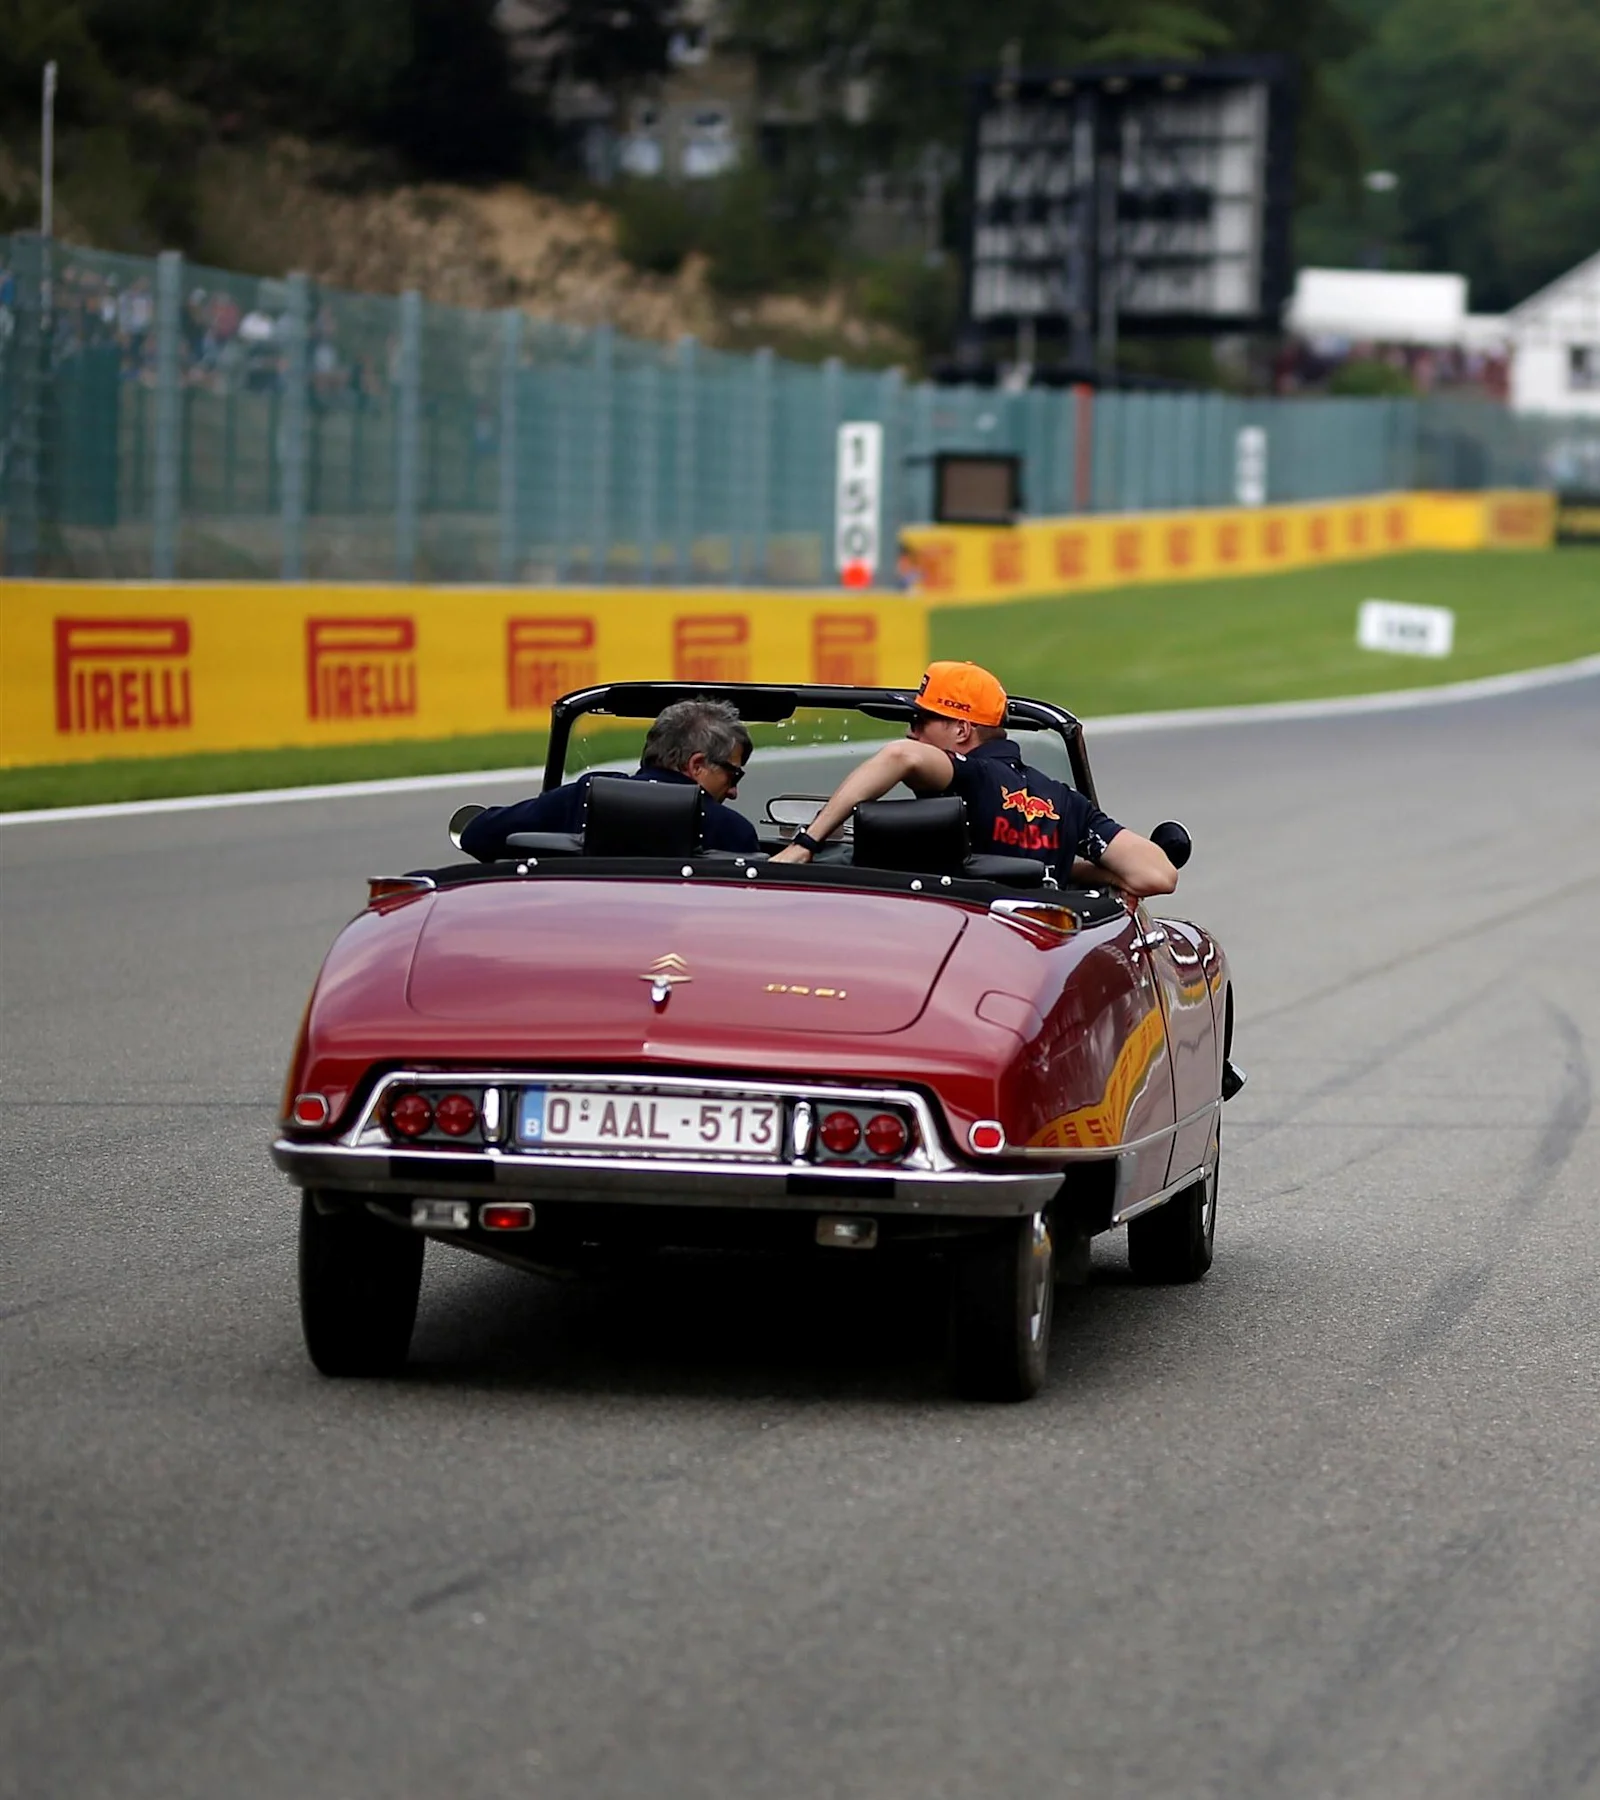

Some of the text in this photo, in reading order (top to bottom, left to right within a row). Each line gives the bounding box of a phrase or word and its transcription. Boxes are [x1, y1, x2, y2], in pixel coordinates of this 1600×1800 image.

[843, 435, 870, 557] 150
[55, 617, 192, 735] PIRELLI
[305, 617, 417, 722] PIRELLI
[524, 1118, 540, 1136] B
